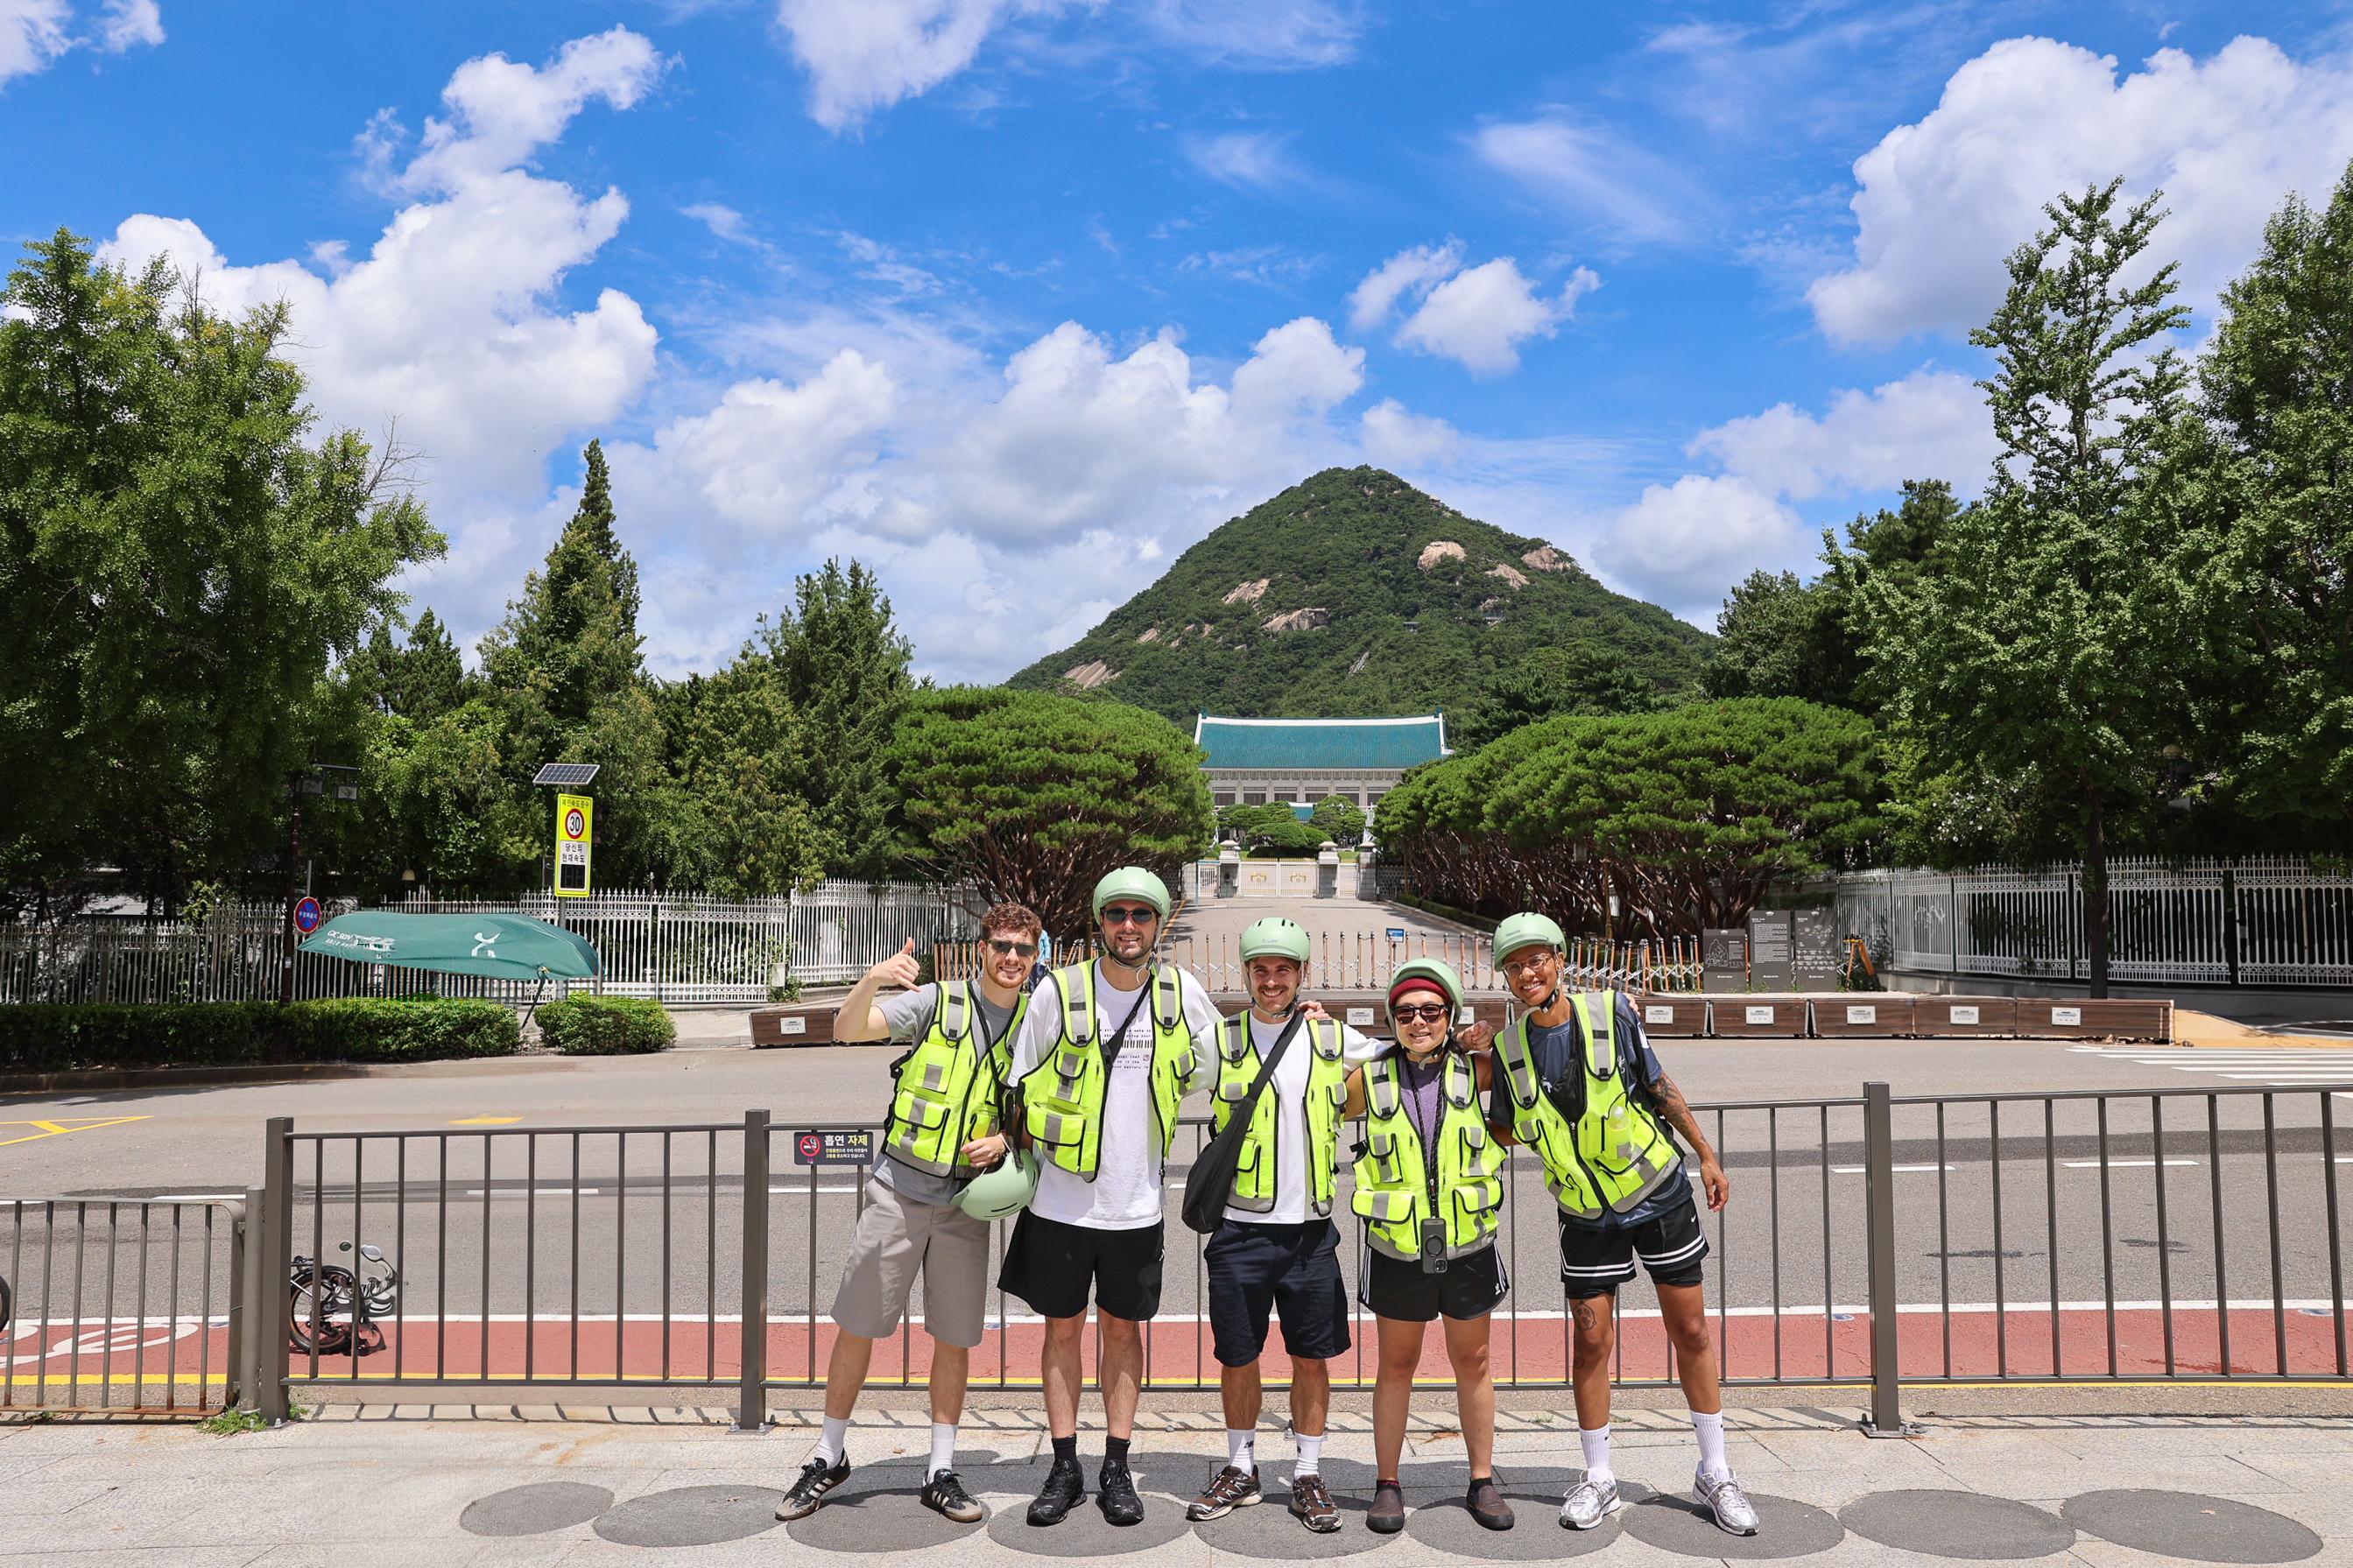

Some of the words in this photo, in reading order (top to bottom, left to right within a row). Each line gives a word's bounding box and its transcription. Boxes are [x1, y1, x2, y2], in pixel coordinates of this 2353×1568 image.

[569, 816, 581, 832] 30
[565, 843, 582, 853] 당신의
[562, 853, 585, 862] 현재속도
[824, 1134, 844, 1146] 흡연
[847, 1134, 868, 1146] 자제
